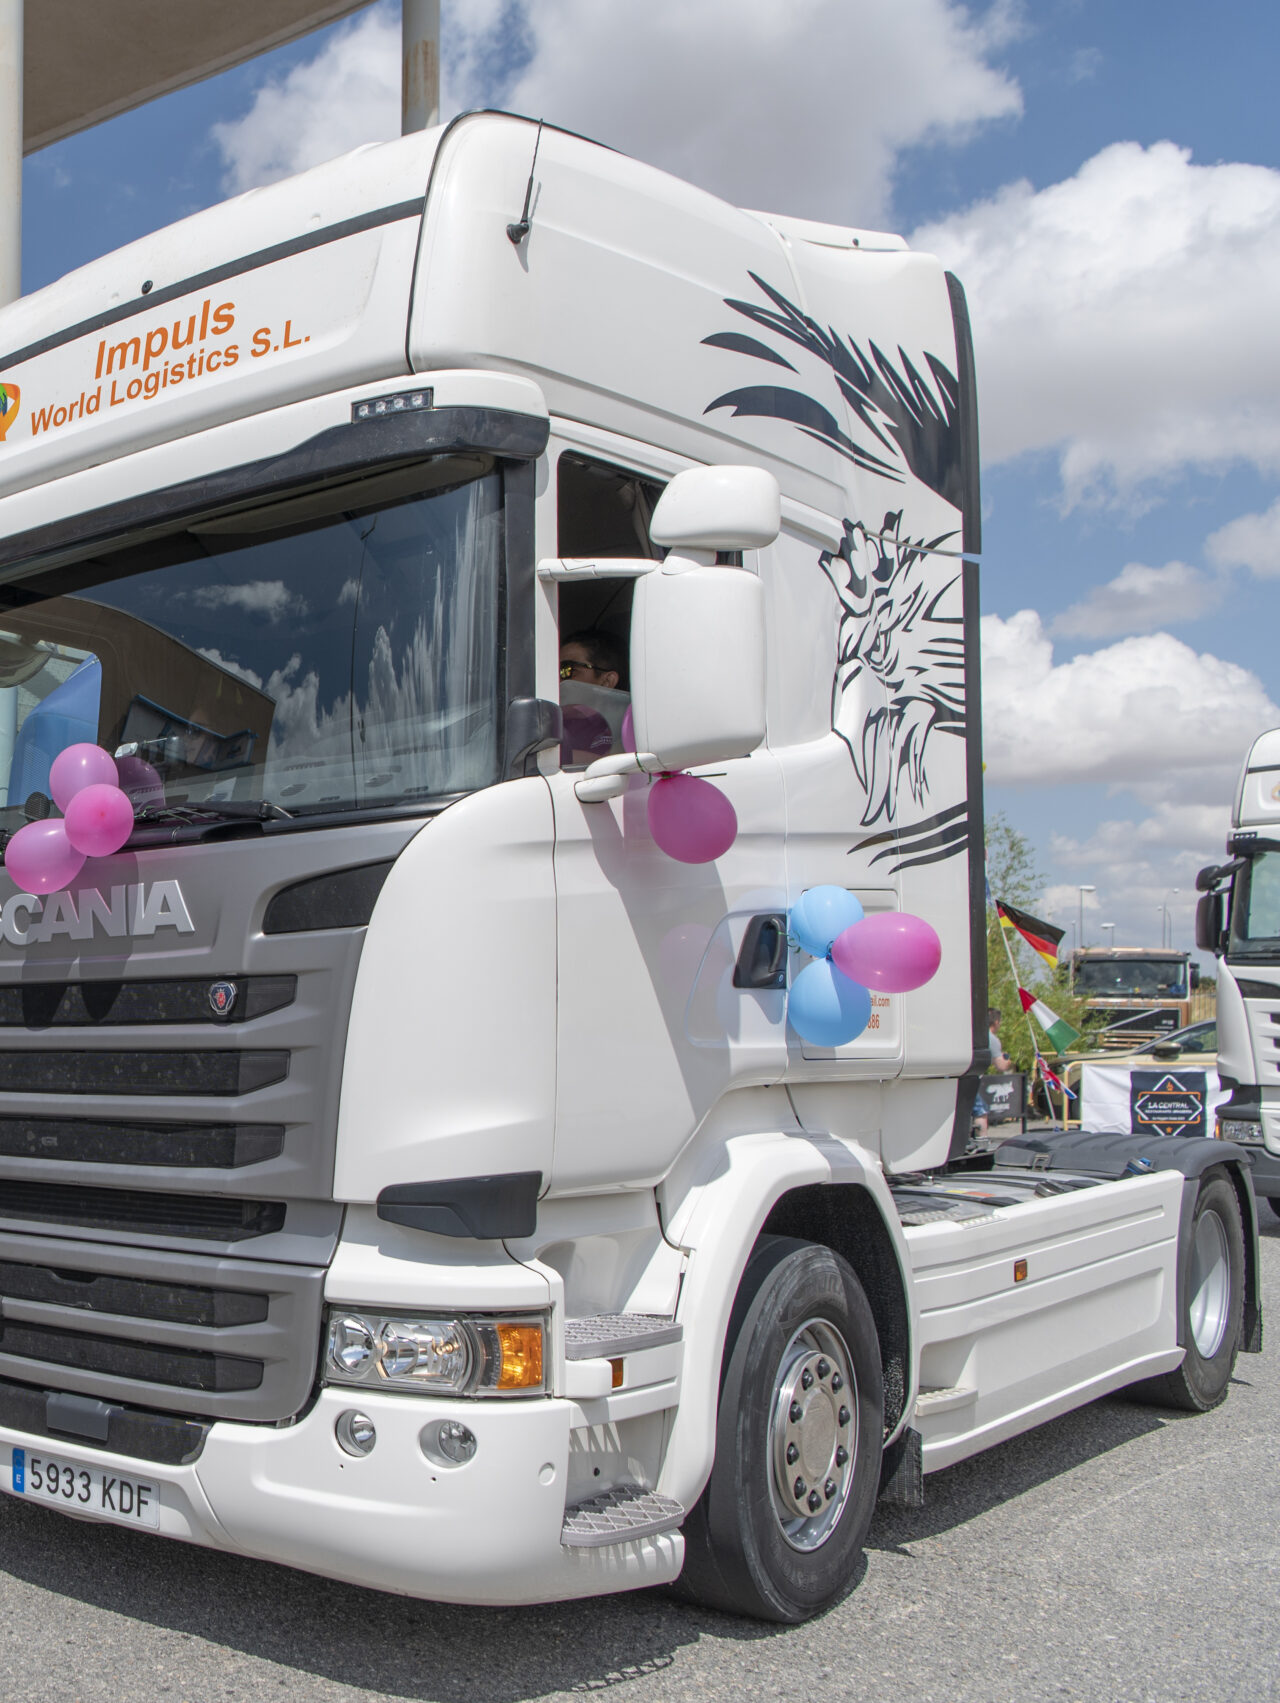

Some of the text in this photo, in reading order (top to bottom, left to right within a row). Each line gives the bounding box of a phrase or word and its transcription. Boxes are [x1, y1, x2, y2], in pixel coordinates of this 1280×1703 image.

[94, 299, 236, 380] Impuls
[31, 319, 311, 436] World Logistics S.L.
[1158, 1101, 1190, 1109] CENTRAL
[16, 1473, 22, 1484] E
[30, 1458, 152, 1518] 5933 KDF
